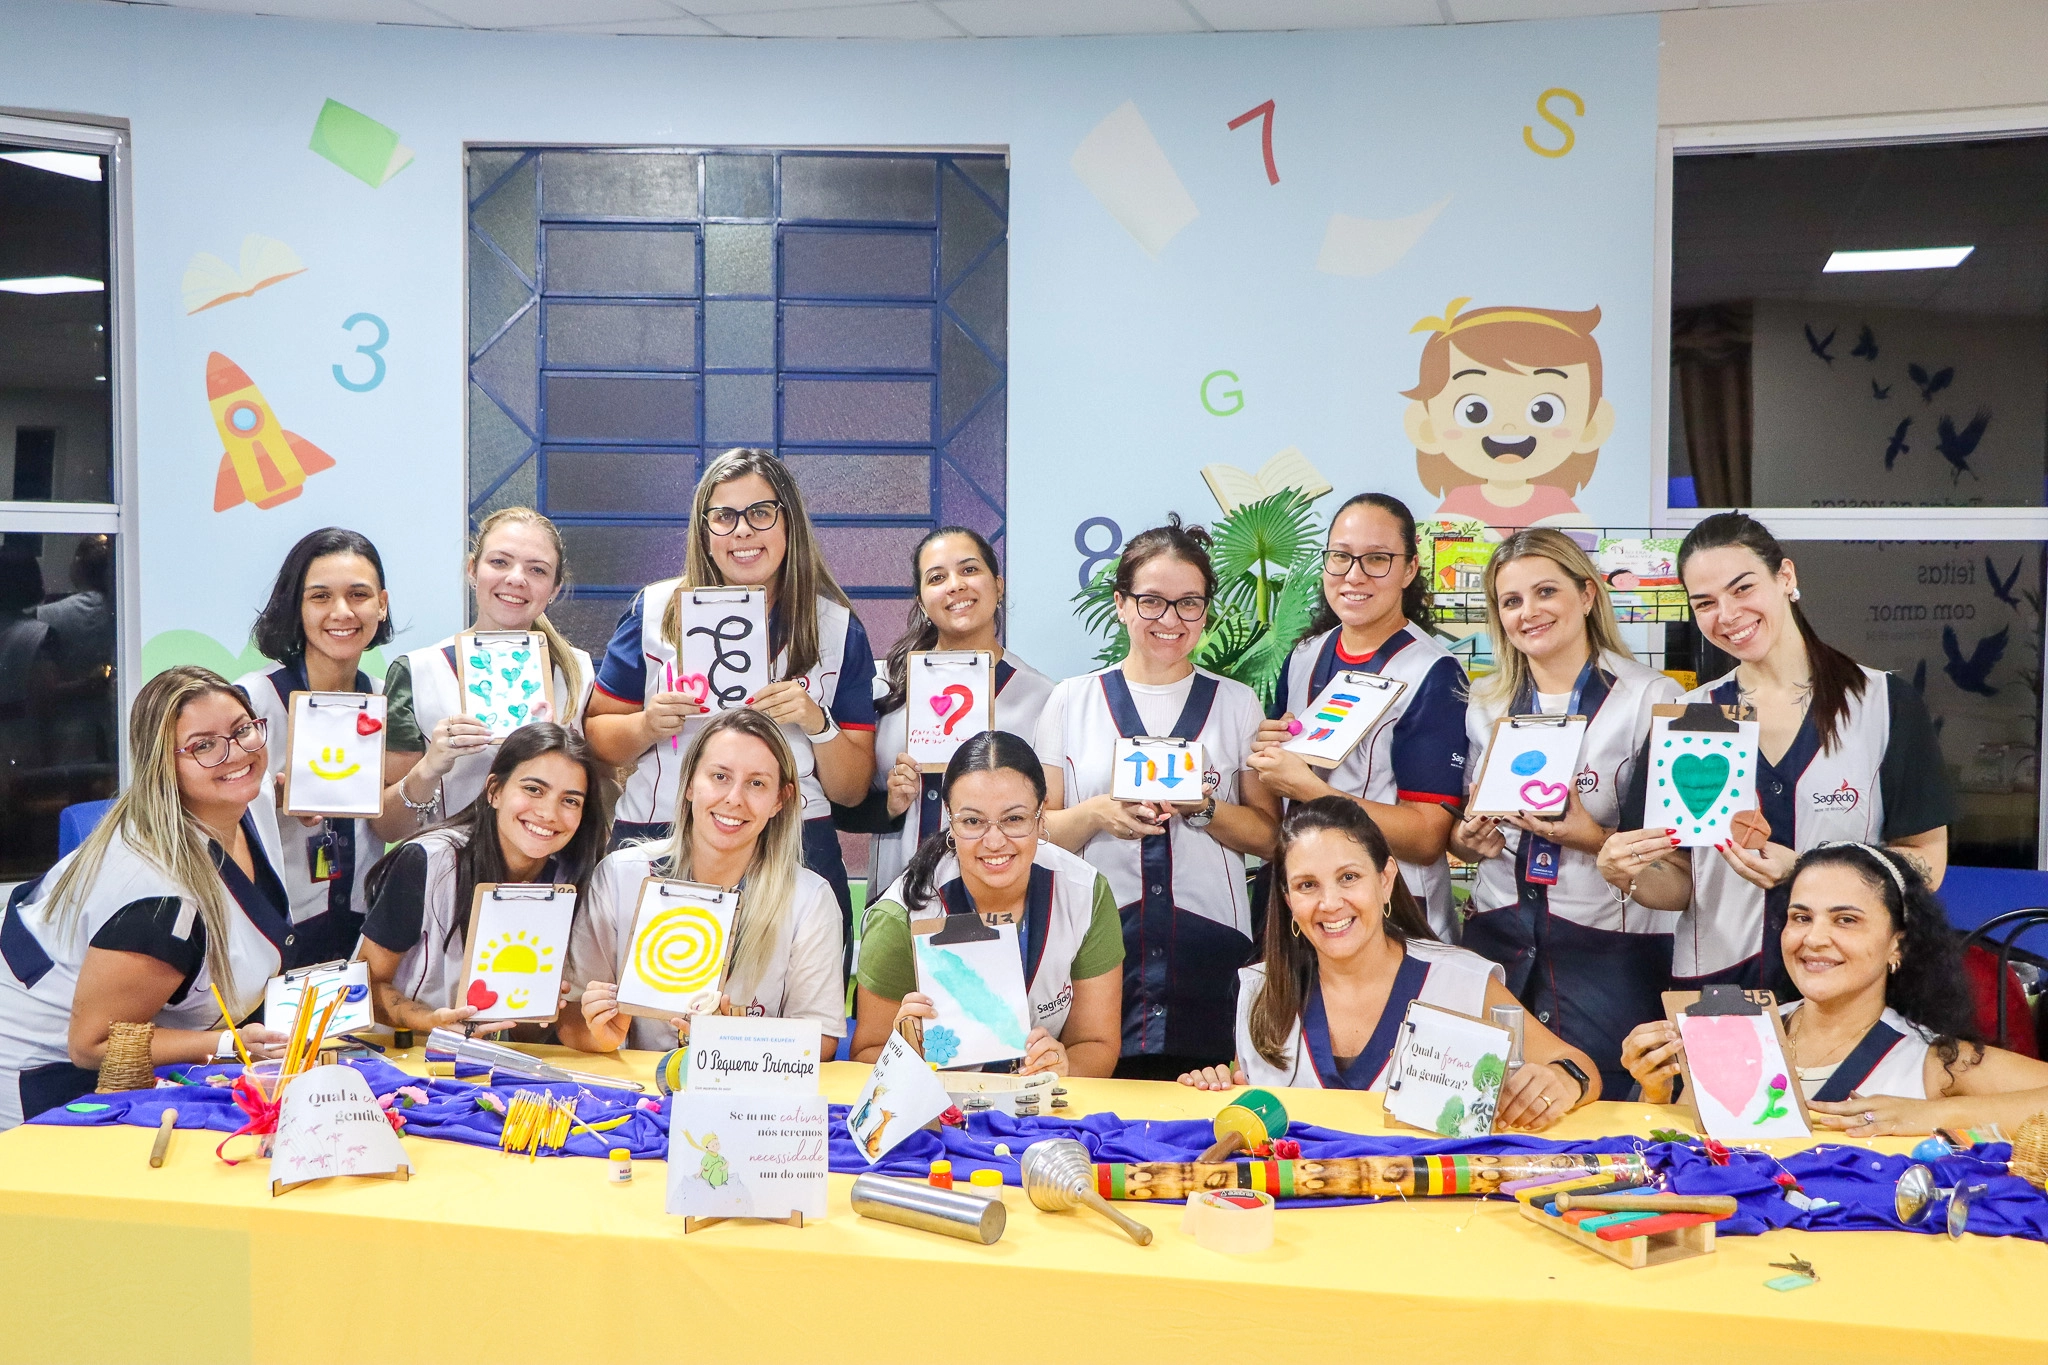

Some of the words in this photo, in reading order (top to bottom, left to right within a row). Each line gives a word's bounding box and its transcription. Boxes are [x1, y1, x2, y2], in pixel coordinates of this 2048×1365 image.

[1522, 88, 1585, 158] S
[1228, 99, 1280, 186] 7
[332, 312, 390, 393] 3
[1200, 370, 1245, 416] G
[1074, 516, 1123, 596] 8
[1813, 791, 1855, 806] Sagrado
[1037, 993, 1071, 1014] Sagrado
[697, 1050, 707, 1070] O
[710, 1049, 759, 1076] Pequeno
[762, 1052, 814, 1078] Príncipe
[1411, 1042, 1434, 1057] Qual
[1434, 1051, 1440, 1060] a
[1441, 1046, 1473, 1070] forma
[1406, 1064, 1417, 1077] da
[1418, 1069, 1468, 1091] gentileza?
[309, 1089, 345, 1107] Qual
[350, 1093, 358, 1101] a
[729, 1111, 744, 1121] Se
[746, 1113, 757, 1121] tu
[760, 1113, 777, 1121] me
[758, 1127, 778, 1136] nós
[780, 1129, 823, 1137] teremos
[749, 1138, 824, 1164] necessidade
[760, 1171, 778, 1179] um
[780, 1169, 794, 1179] do
[796, 1170, 824, 1179] outro
